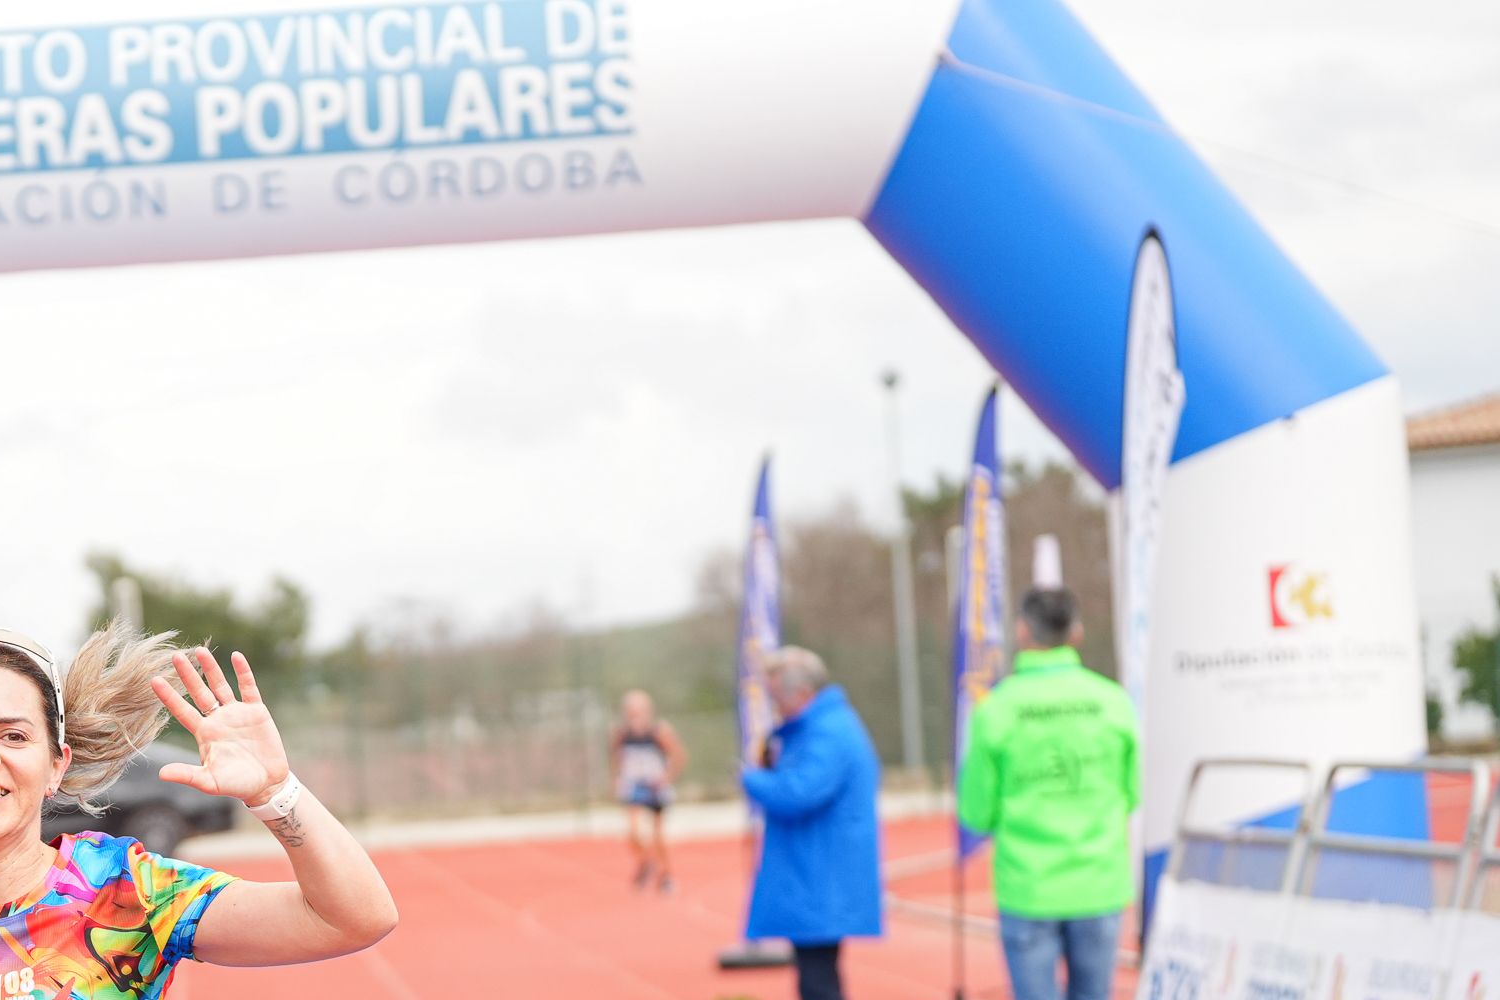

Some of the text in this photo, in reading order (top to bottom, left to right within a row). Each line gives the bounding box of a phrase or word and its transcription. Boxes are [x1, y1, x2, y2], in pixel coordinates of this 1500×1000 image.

[109, 1, 526, 87] PROVINCIAL
[544, 0, 635, 62] DE
[197, 60, 636, 158] POPULARES
[212, 171, 289, 214] DE
[333, 148, 643, 207] CÓRDOBA
[4, 967, 35, 994] 08
